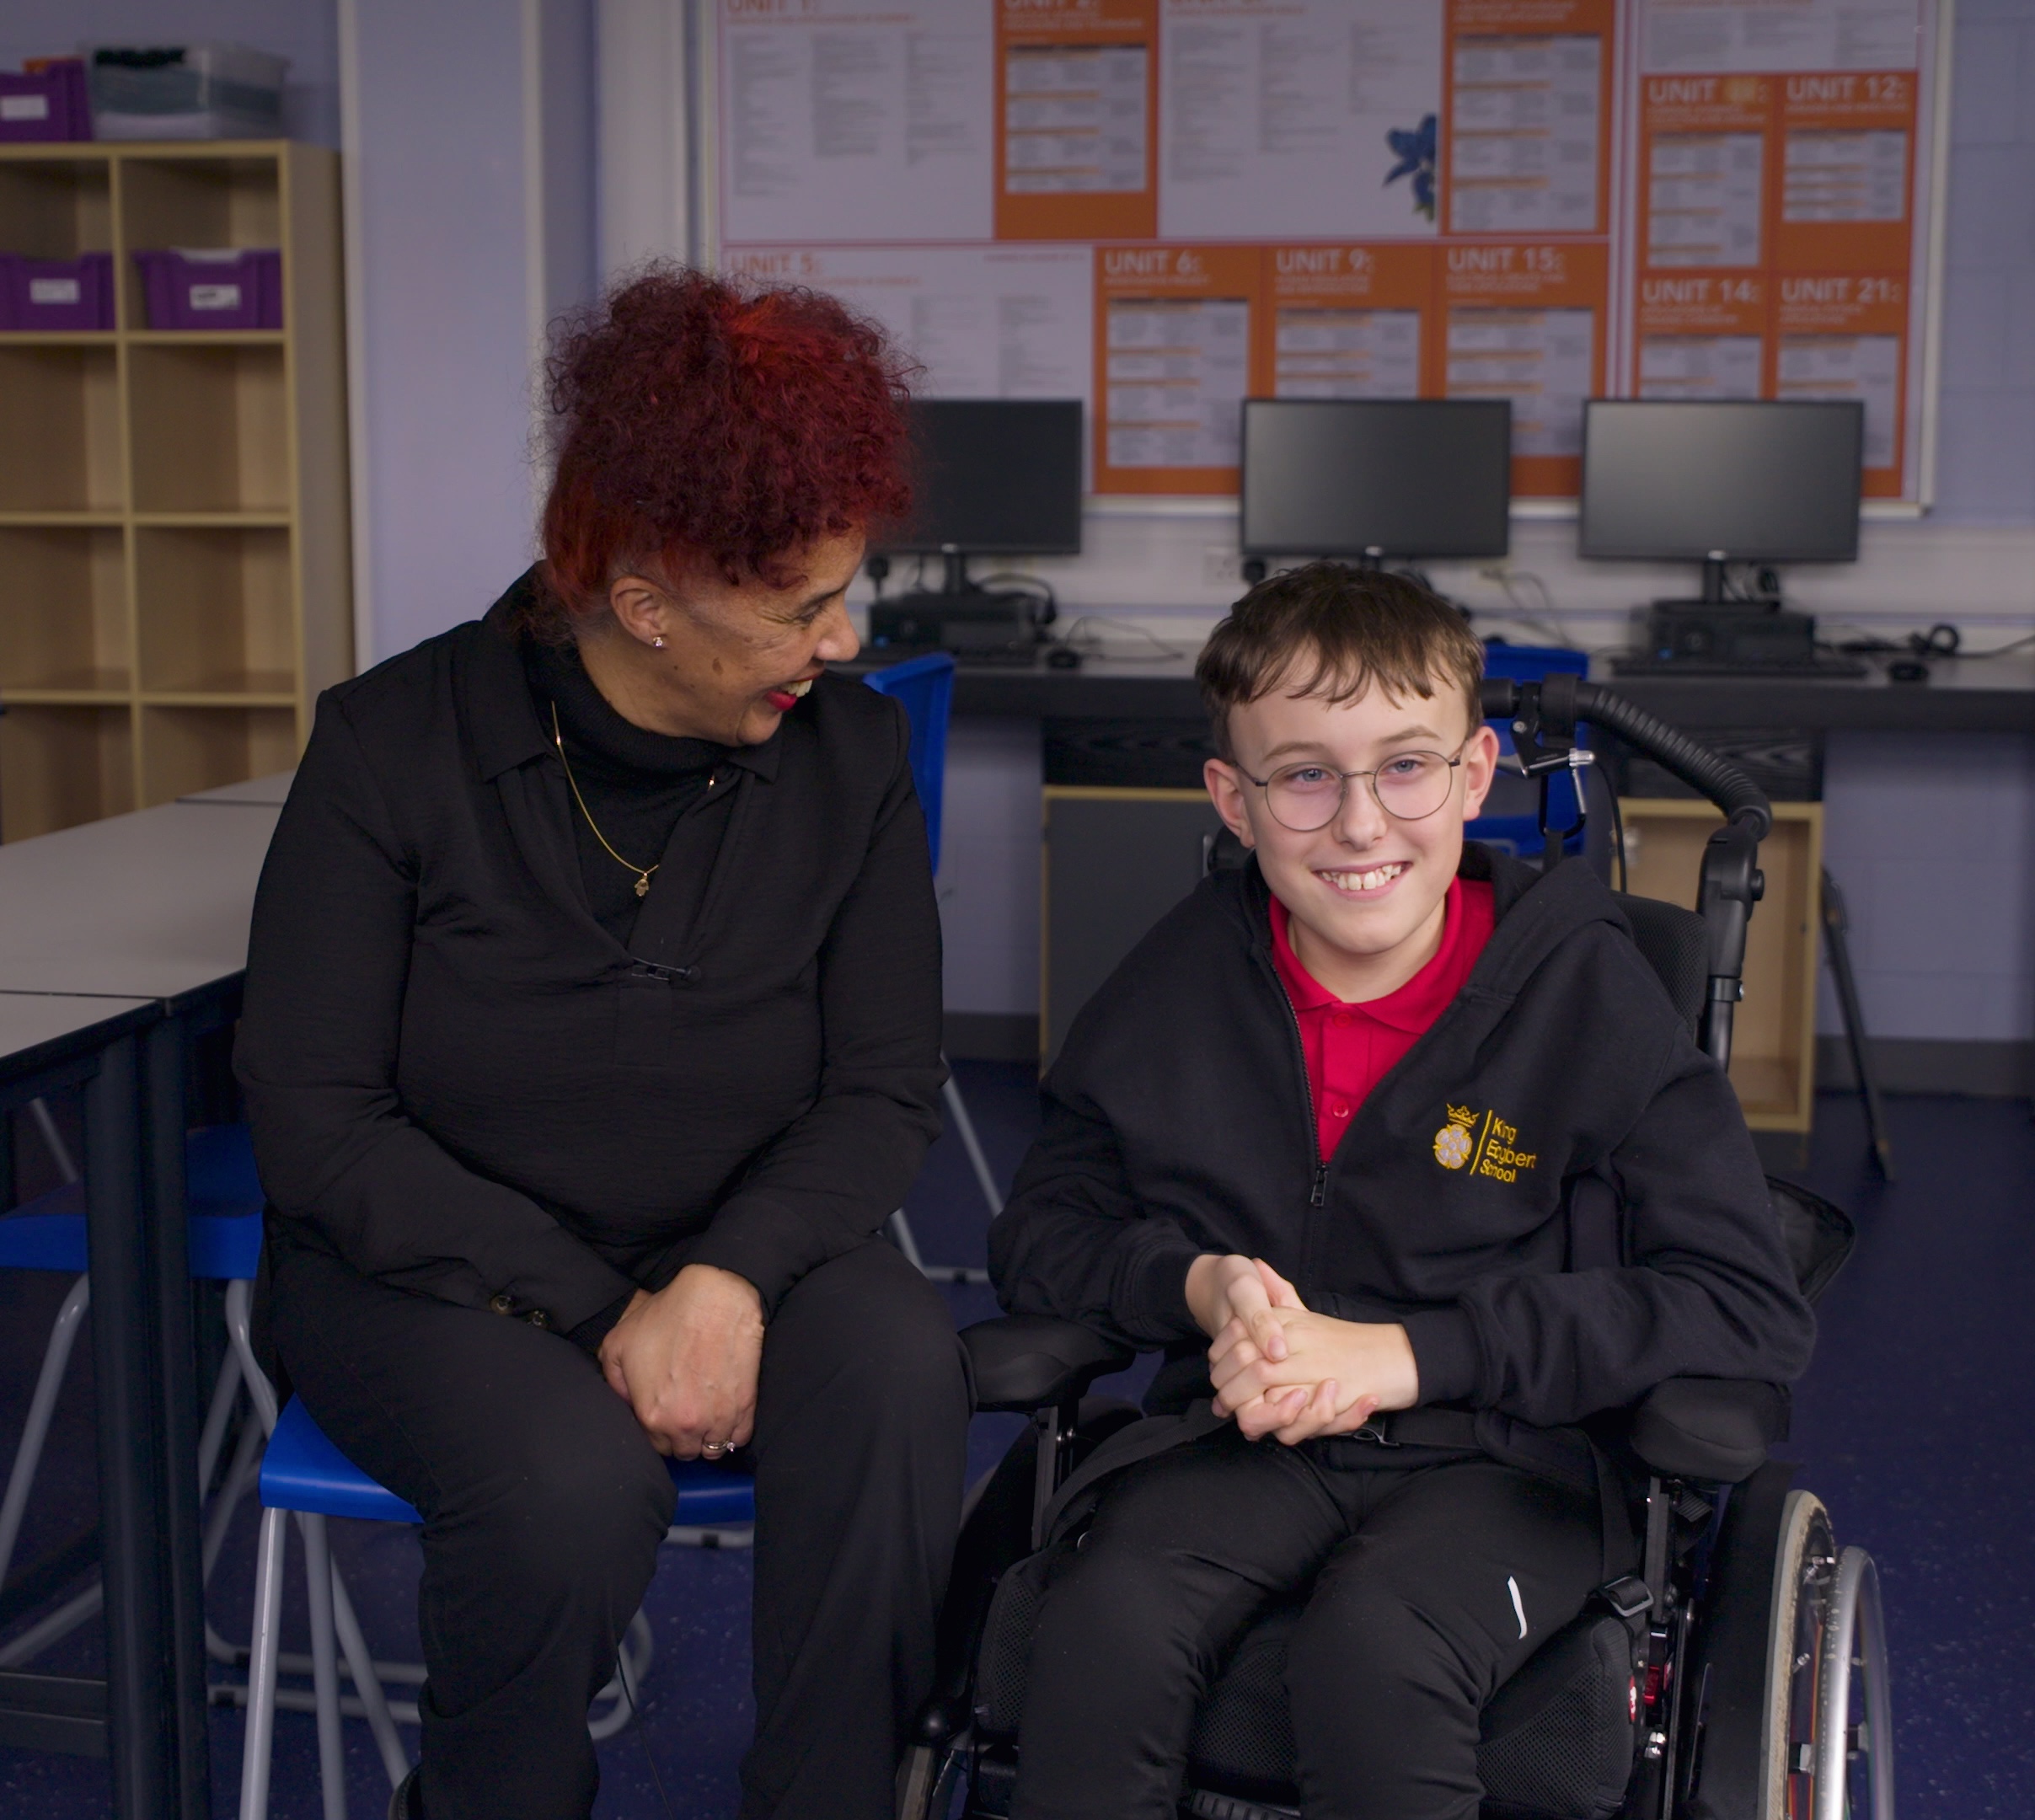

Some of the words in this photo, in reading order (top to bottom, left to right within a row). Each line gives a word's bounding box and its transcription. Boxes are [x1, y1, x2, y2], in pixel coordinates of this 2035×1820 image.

[1648, 78, 1717, 103] UNIT
[1786, 76, 1856, 101] UNIT
[731, 253, 792, 274] UNIT
[1104, 249, 1169, 273] UNIT
[1276, 249, 1341, 272] UNIT
[1447, 248, 1513, 271] UNIT
[1641, 279, 1710, 303] UNIT
[1779, 276, 1849, 303] UNIT
